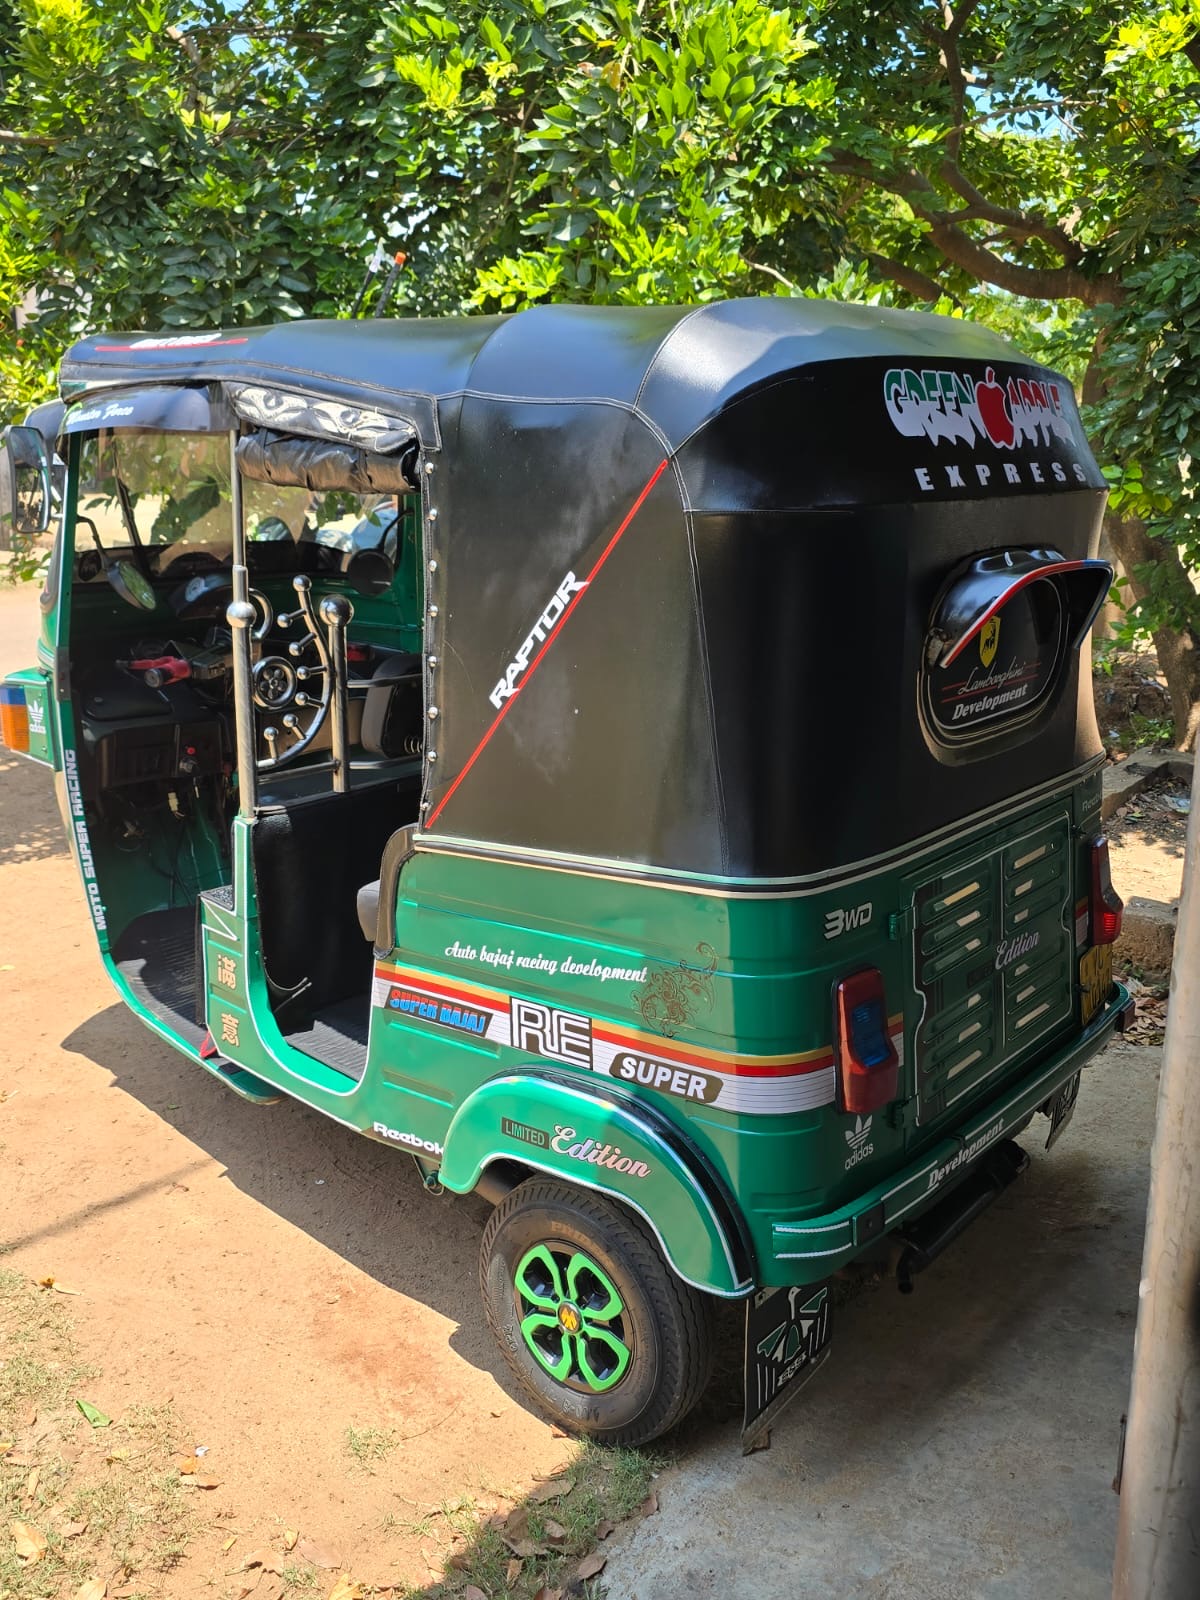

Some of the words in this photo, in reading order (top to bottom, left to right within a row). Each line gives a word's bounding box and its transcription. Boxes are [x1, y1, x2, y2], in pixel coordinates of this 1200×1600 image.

[914, 461, 1087, 491] EXPRESS
[489, 570, 590, 709] RAPTOR
[957, 656, 1026, 694] Lamborghini
[952, 683, 1028, 720] Development
[65, 749, 84, 816] RACING
[75, 820, 96, 879] SUPER
[87, 882, 107, 930] MOTO
[824, 902, 873, 939] 3WD
[444, 941, 477, 960] Auto
[479, 945, 514, 970] bajaj
[516, 953, 559, 976] racing
[560, 956, 648, 983] development
[995, 931, 1039, 970] Edition
[389, 989, 438, 1019] SUPER
[439, 1002, 486, 1033] BAJAJ
[510, 996, 592, 1069] RE
[620, 1056, 708, 1100] SUPER
[373, 1121, 444, 1155] Reebok
[504, 1120, 546, 1146] LIMITED
[550, 1124, 652, 1179] Edition
[844, 1143, 874, 1170] adidas
[927, 1118, 1005, 1189] Development
